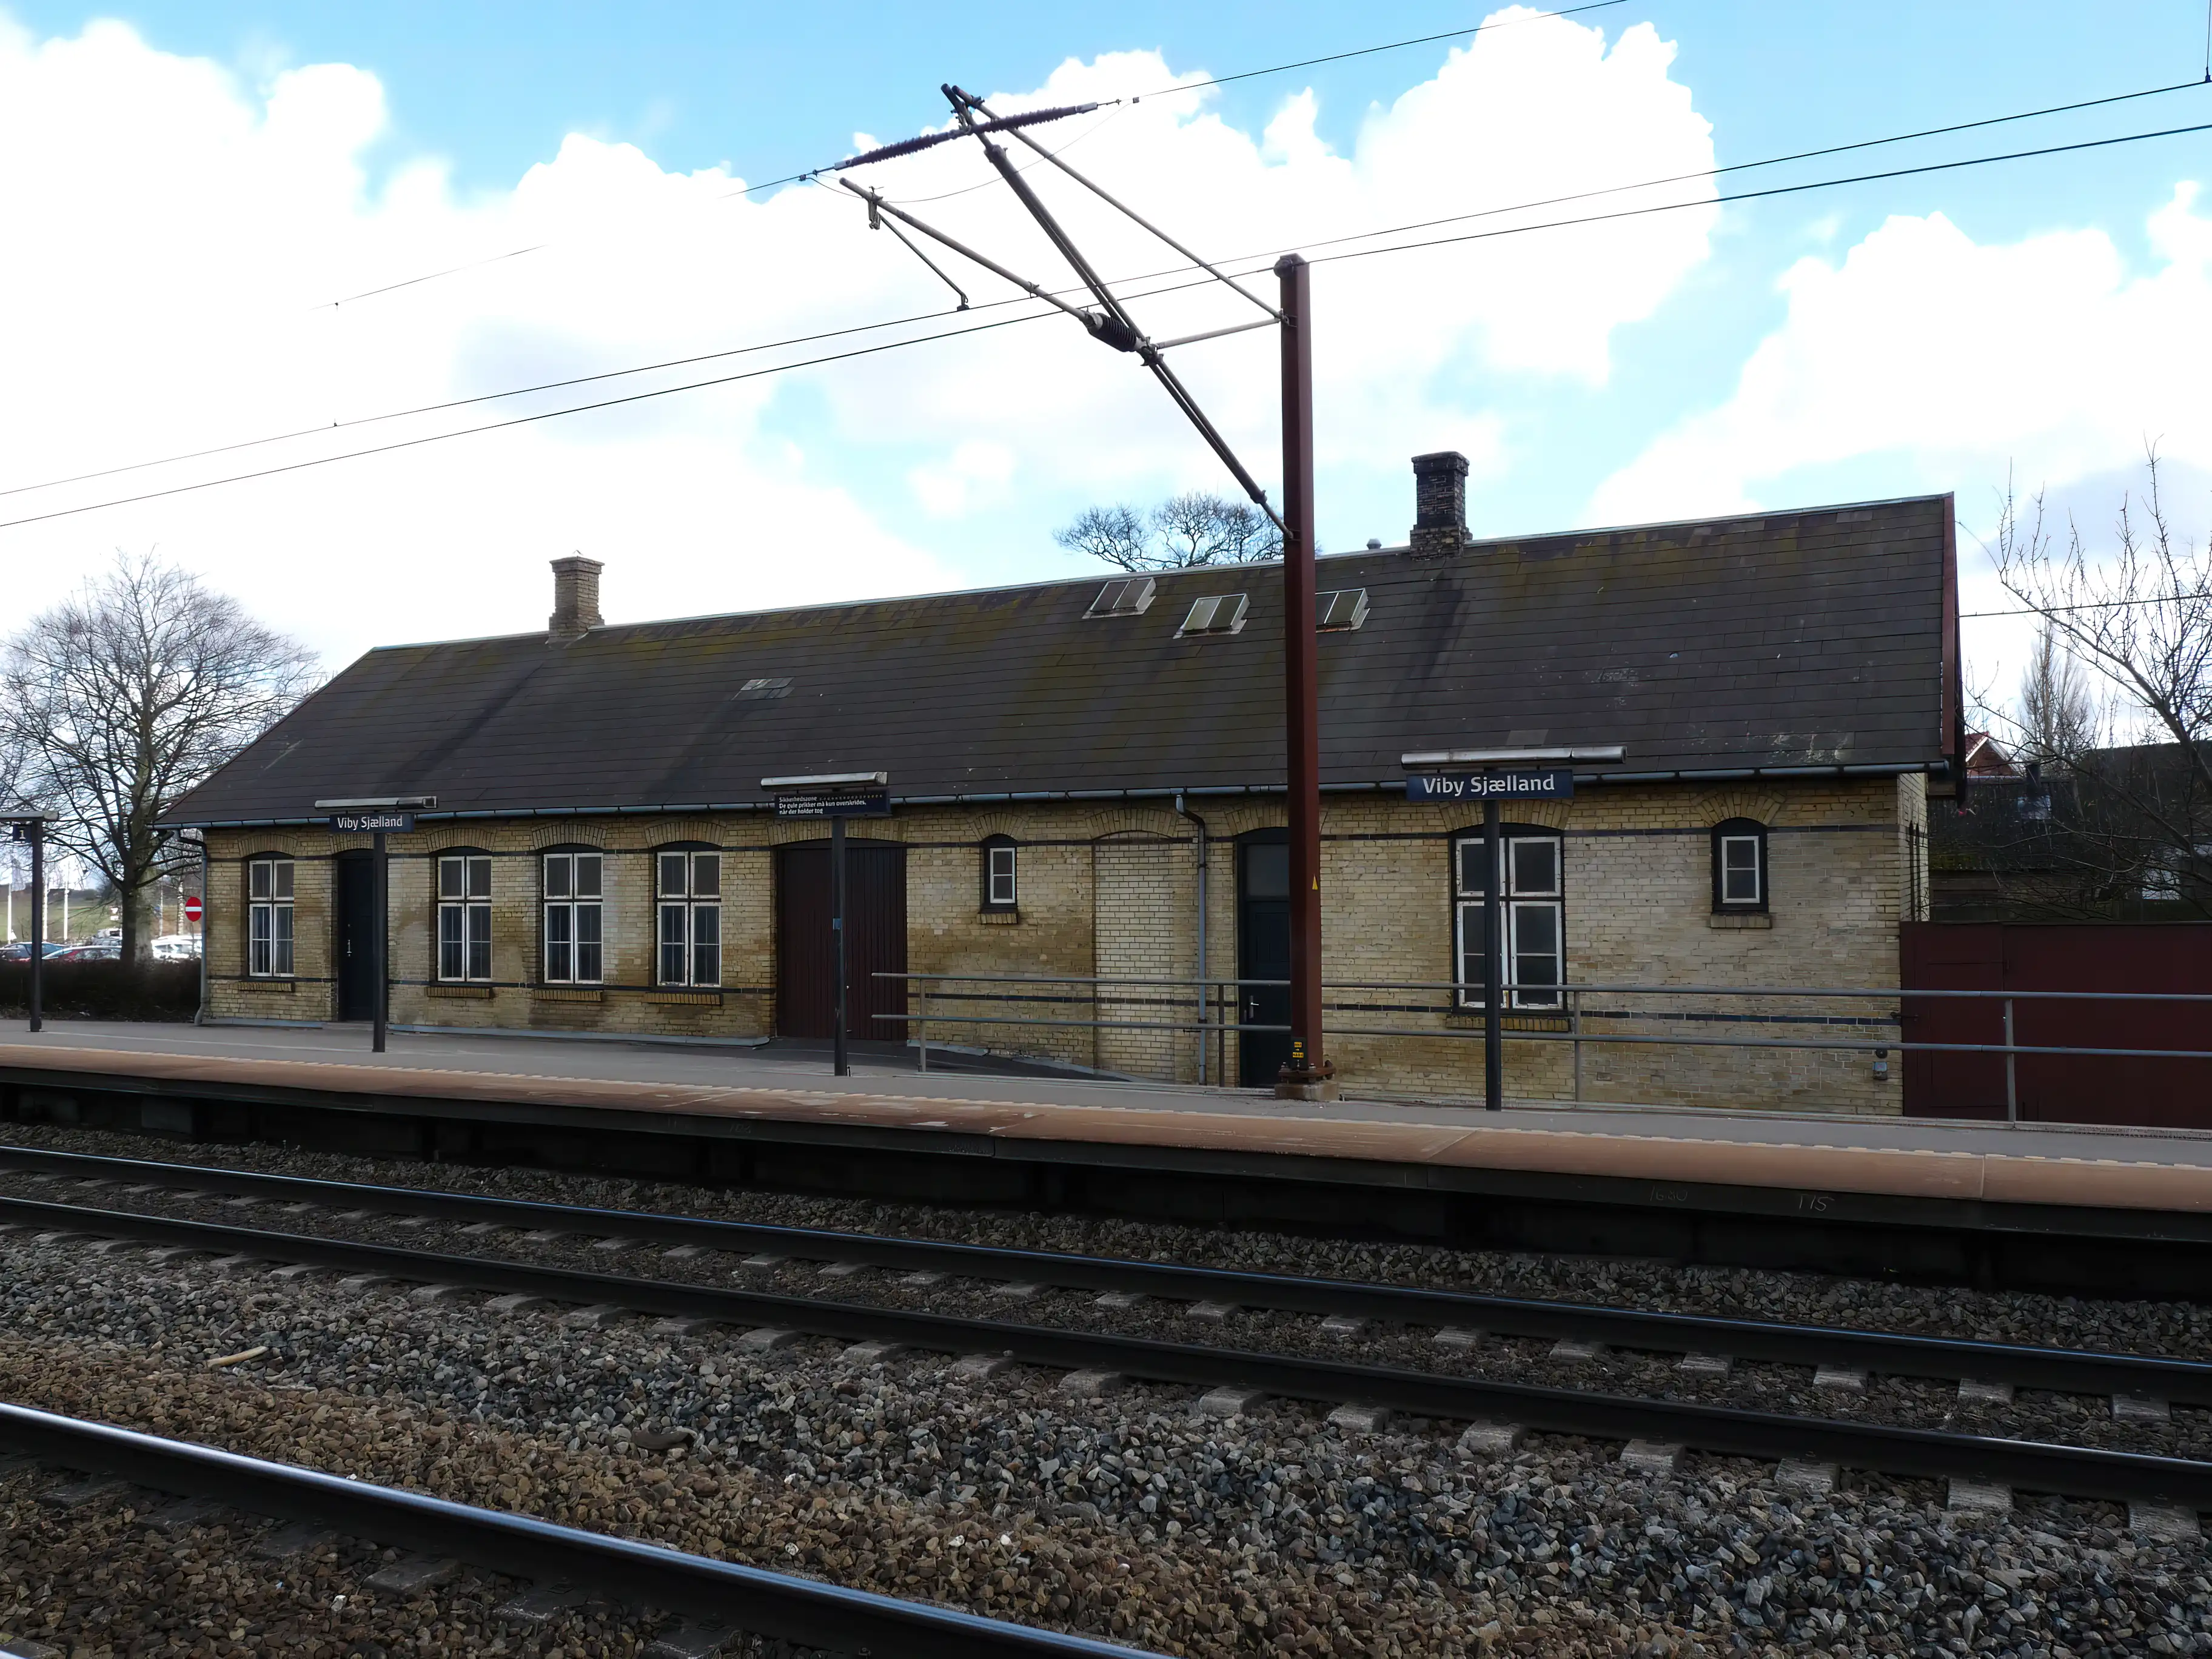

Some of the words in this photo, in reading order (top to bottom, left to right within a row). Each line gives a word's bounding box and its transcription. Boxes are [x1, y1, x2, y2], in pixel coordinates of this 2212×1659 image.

[1423, 777, 1464, 796] Viby
[1470, 774, 1555, 796] Sjælland
[337, 817, 358, 831] Viby
[361, 815, 403, 830] Sjælland
